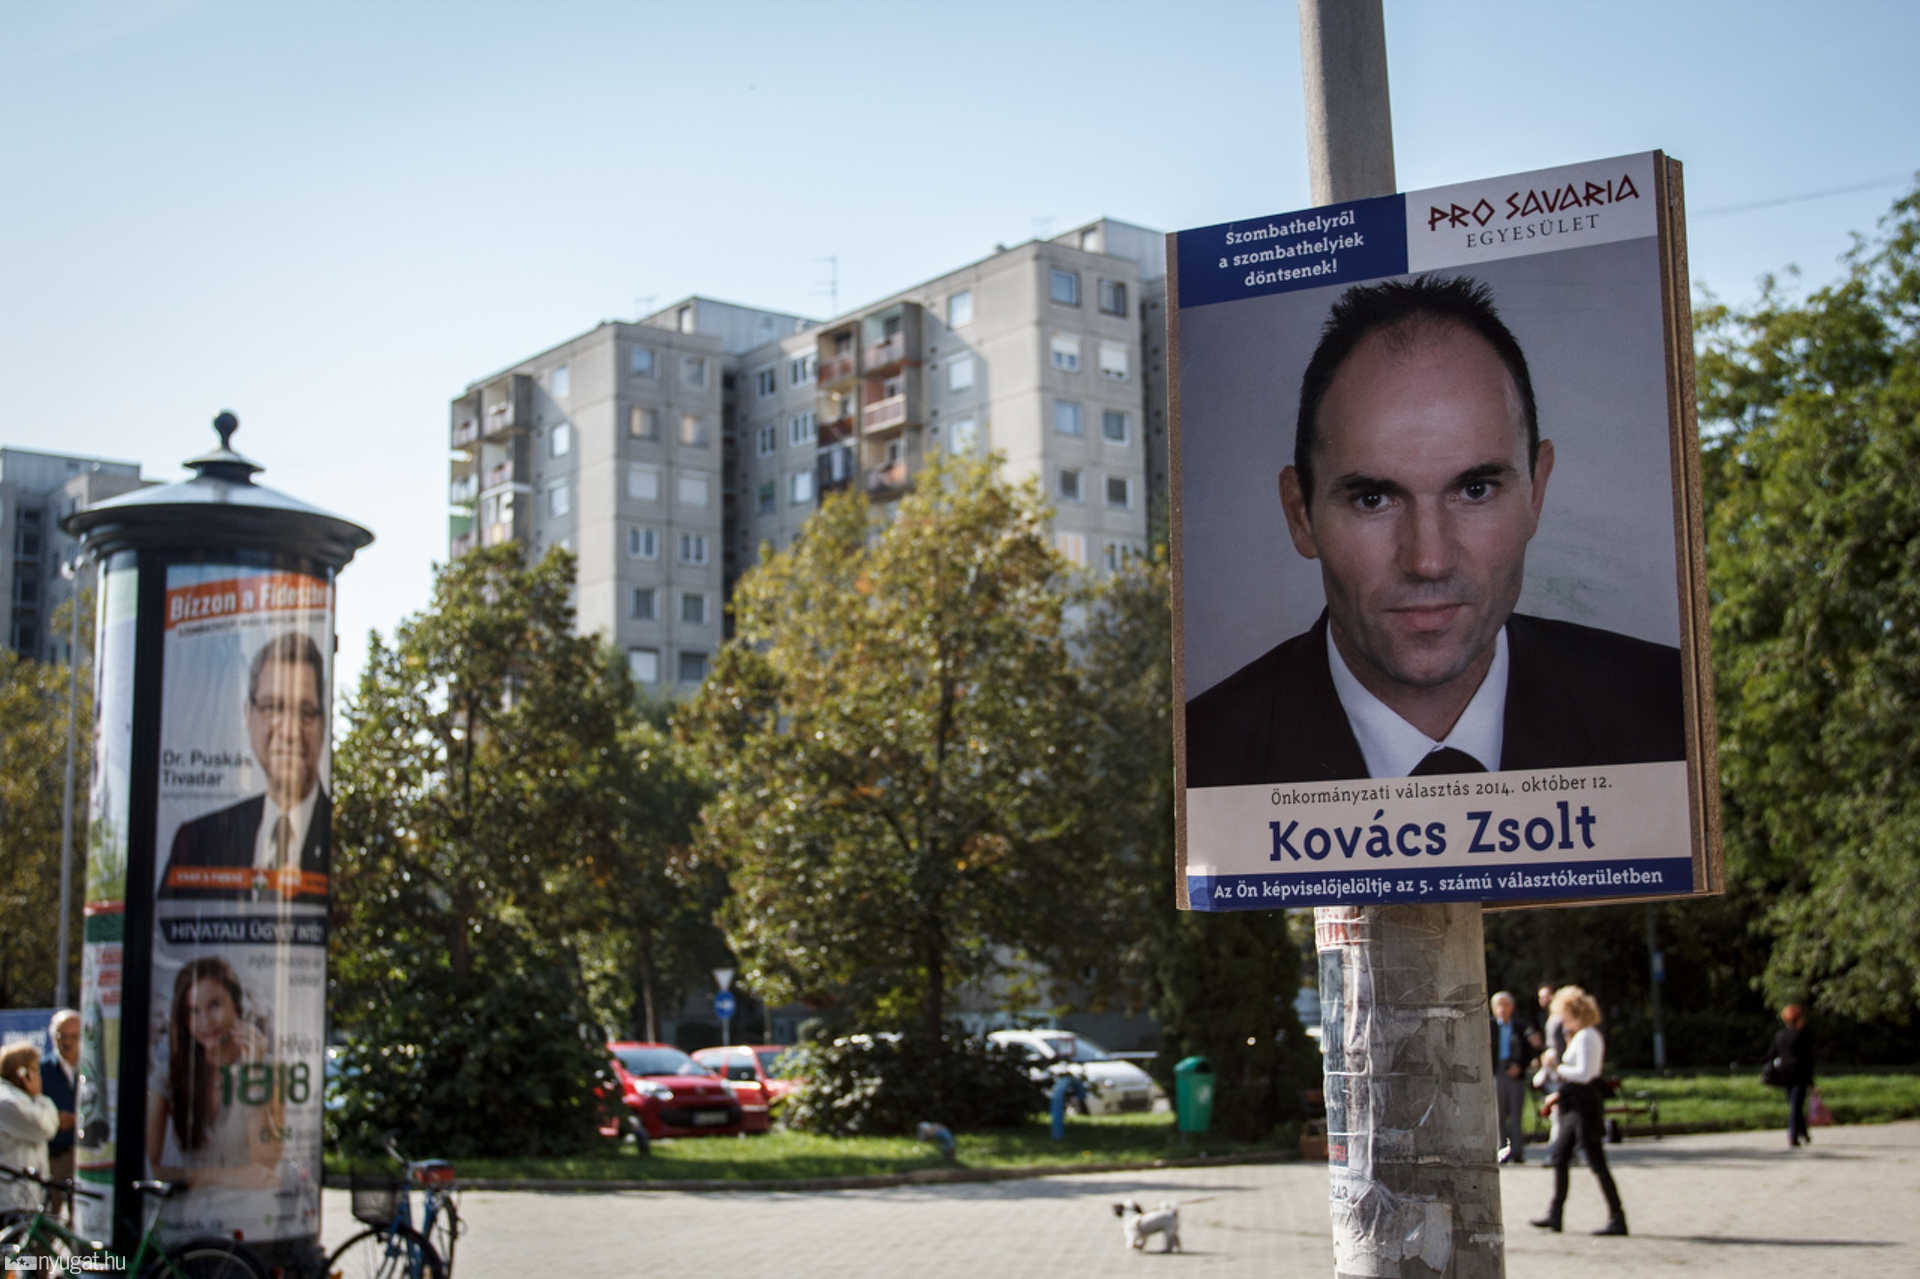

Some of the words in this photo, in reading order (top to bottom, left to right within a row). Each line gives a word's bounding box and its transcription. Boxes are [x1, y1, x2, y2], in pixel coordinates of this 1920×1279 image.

[1428, 198, 1495, 231] PRO
[1505, 173, 1640, 220] SAVARIA
[1225, 210, 1355, 245] Szombathelyről
[1466, 213, 1600, 248] EGYESÜLET
[1218, 256, 1228, 268] a
[1233, 232, 1364, 266] szombathelyiek
[1244, 258, 1338, 287] döntsenek!
[163, 768, 224, 786] Tivadar
[1271, 785, 1390, 805] Önkormányzati
[1396, 780, 1469, 799] választás
[1476, 783, 1515, 797] 2014.
[1521, 774, 1587, 793] október
[1593, 776, 1613, 789] 12.
[1269, 808, 1447, 861] Kovács
[1467, 800, 1596, 853] Zsolt
[1214, 885, 1232, 899] Az
[1236, 880, 1258, 897] Ön
[1262, 877, 1392, 901] képviselőjelöltje
[1396, 880, 1414, 892] az
[1419, 880, 1433, 894] 5.
[1439, 872, 1493, 891] számú
[1497, 867, 1664, 889] választókerületben
[171, 921, 246, 939] HIVATALI
[219, 1061, 310, 1106] 1818
